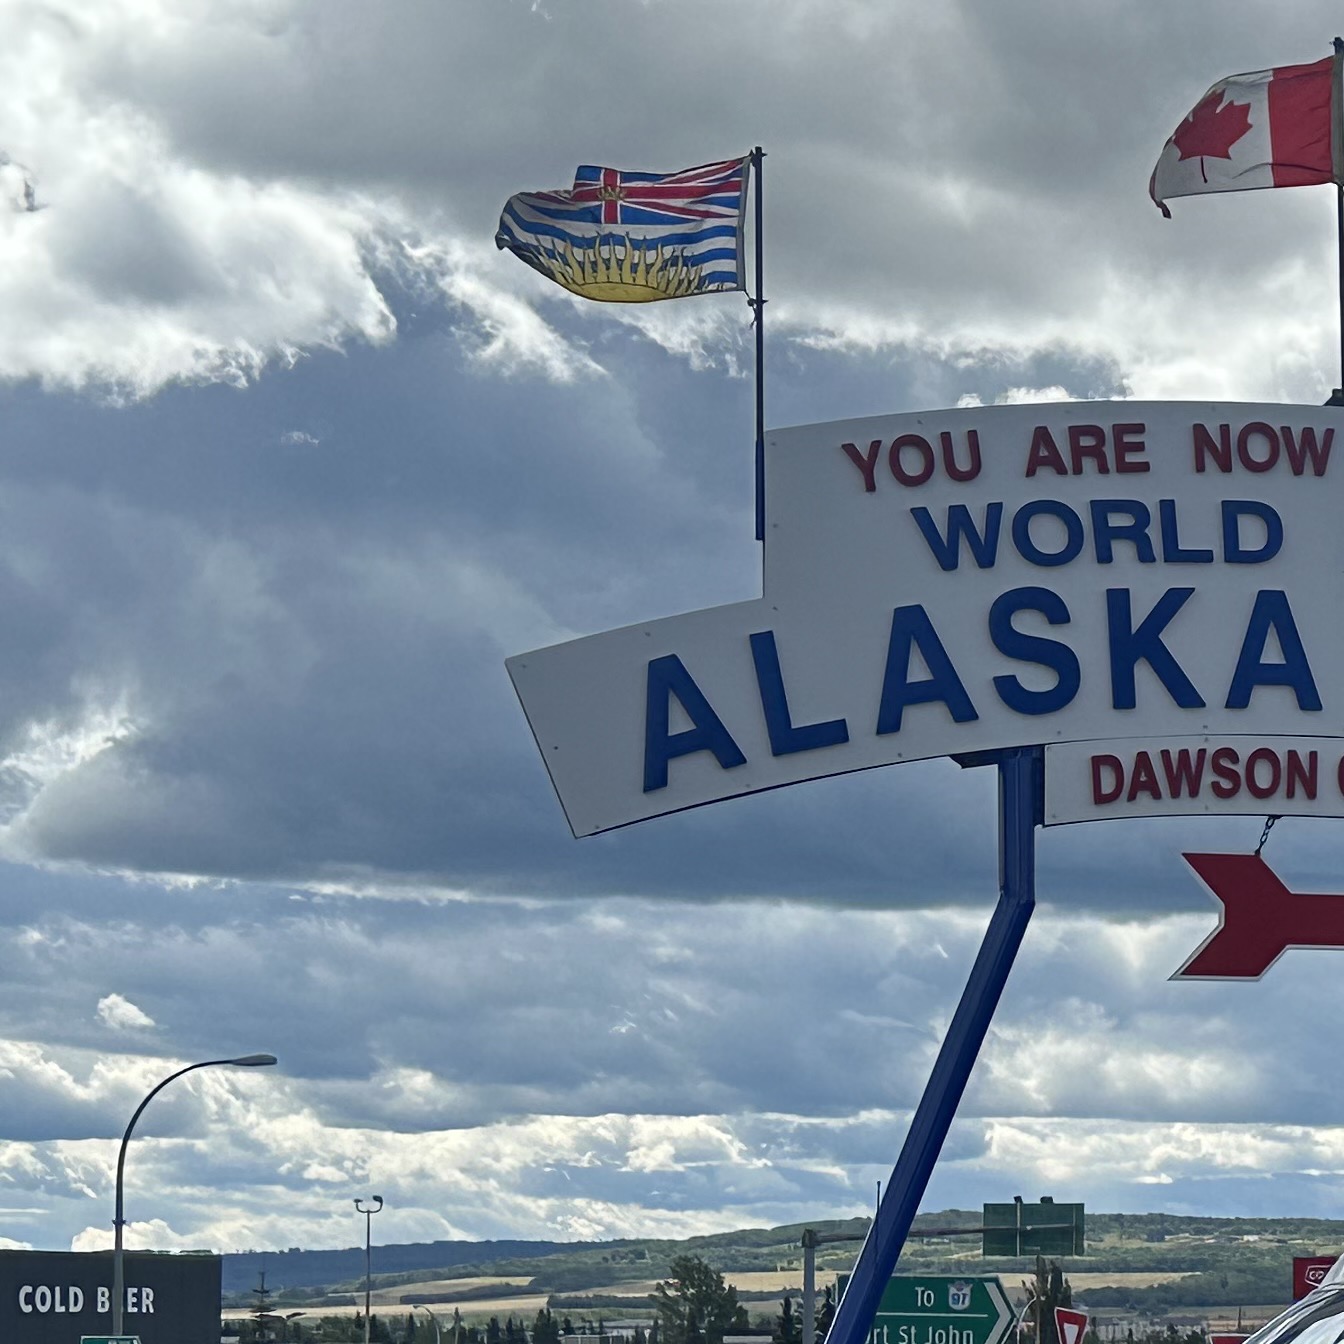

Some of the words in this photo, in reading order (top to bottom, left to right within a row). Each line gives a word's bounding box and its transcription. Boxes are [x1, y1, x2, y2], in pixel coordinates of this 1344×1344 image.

[842, 429, 982, 493] YOU
[1025, 422, 1150, 477] ARE
[1193, 421, 1335, 476] NOW
[910, 498, 1284, 571] WORLD
[643, 586, 1323, 794] ALASKA
[1090, 747, 1319, 805] DAWSON
[18, 1284, 84, 1314] COLD
[96, 1286, 155, 1314] BER
[914, 1286, 935, 1307] To
